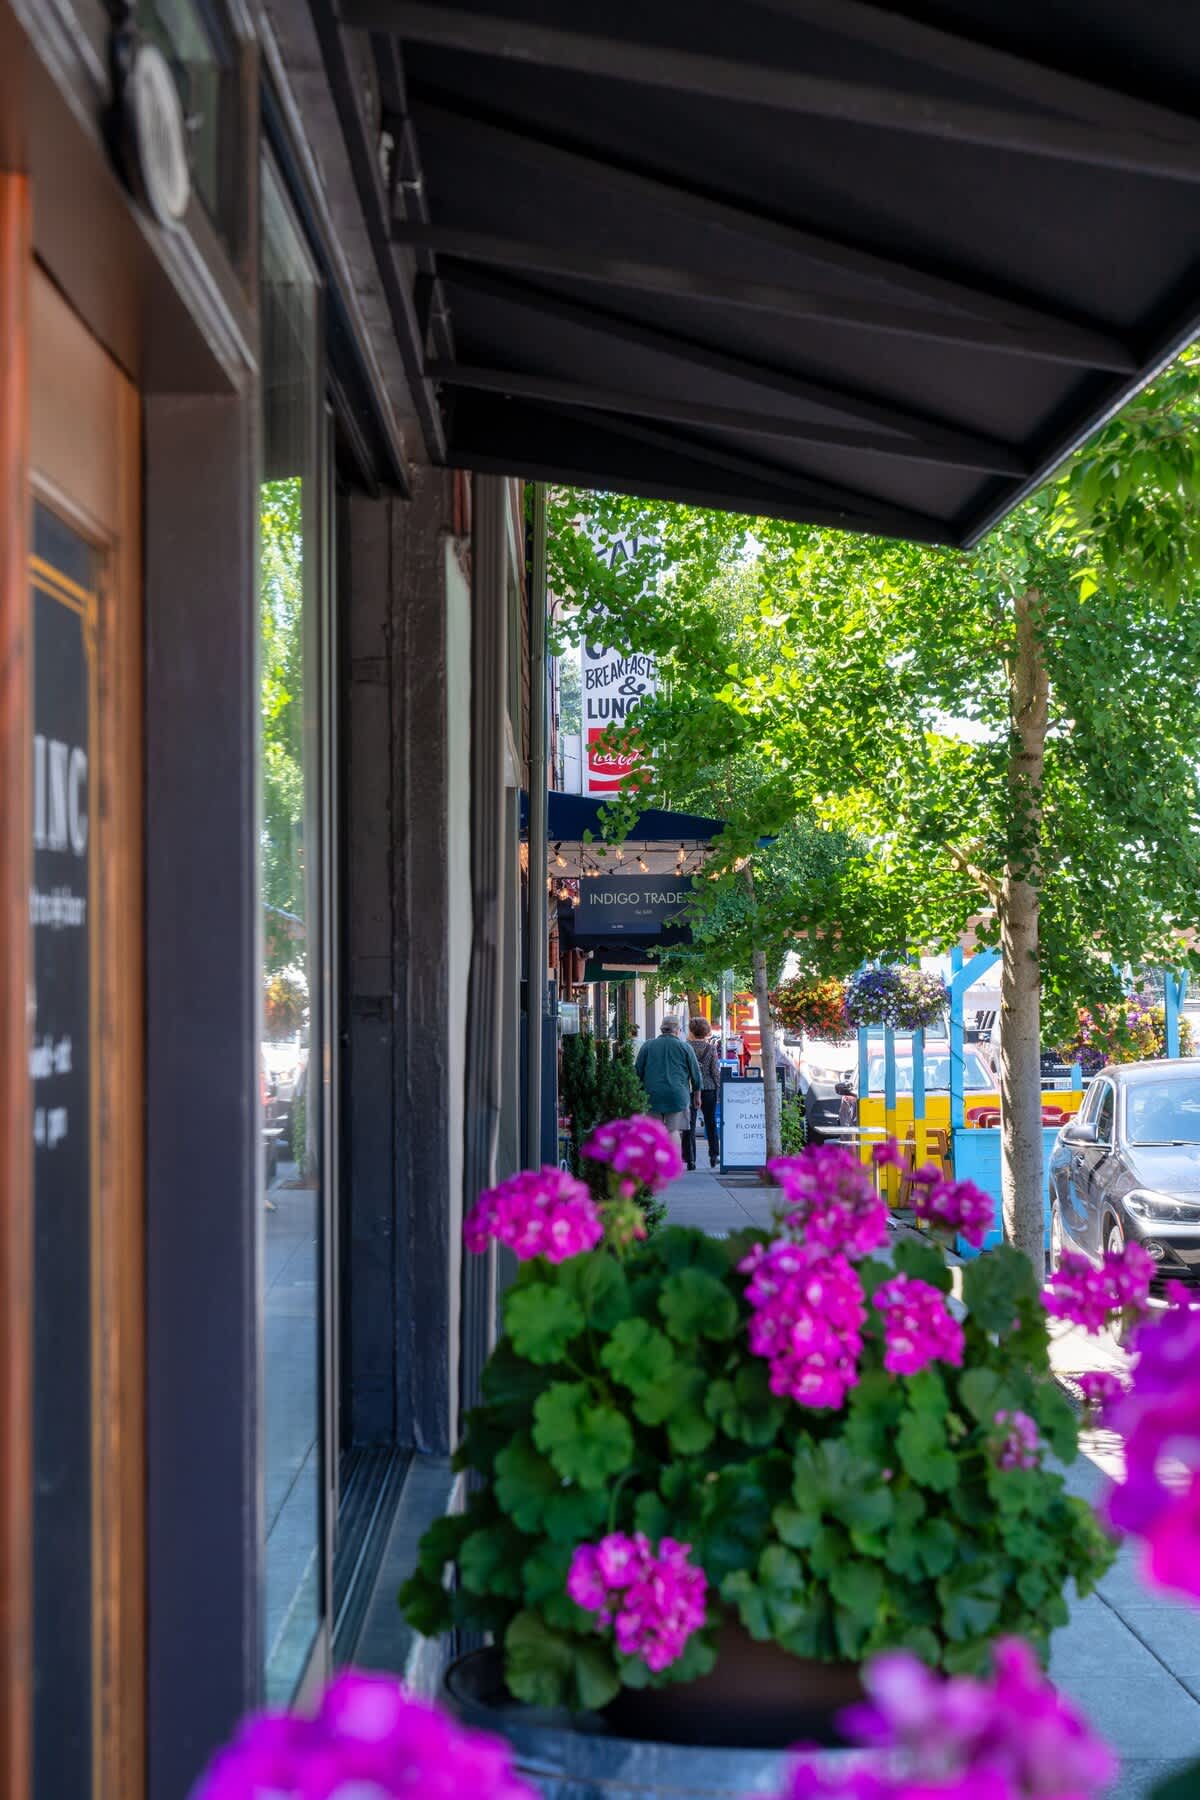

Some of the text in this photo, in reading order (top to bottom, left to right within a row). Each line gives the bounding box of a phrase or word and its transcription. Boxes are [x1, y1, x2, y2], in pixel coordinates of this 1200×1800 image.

[585, 655, 653, 690] BREAKFAST
[618, 676, 646, 696] &
[587, 697, 644, 719] LUNC
[590, 892, 697, 905] INDIGO TRADE
[739, 1112, 766, 1120] PLANT
